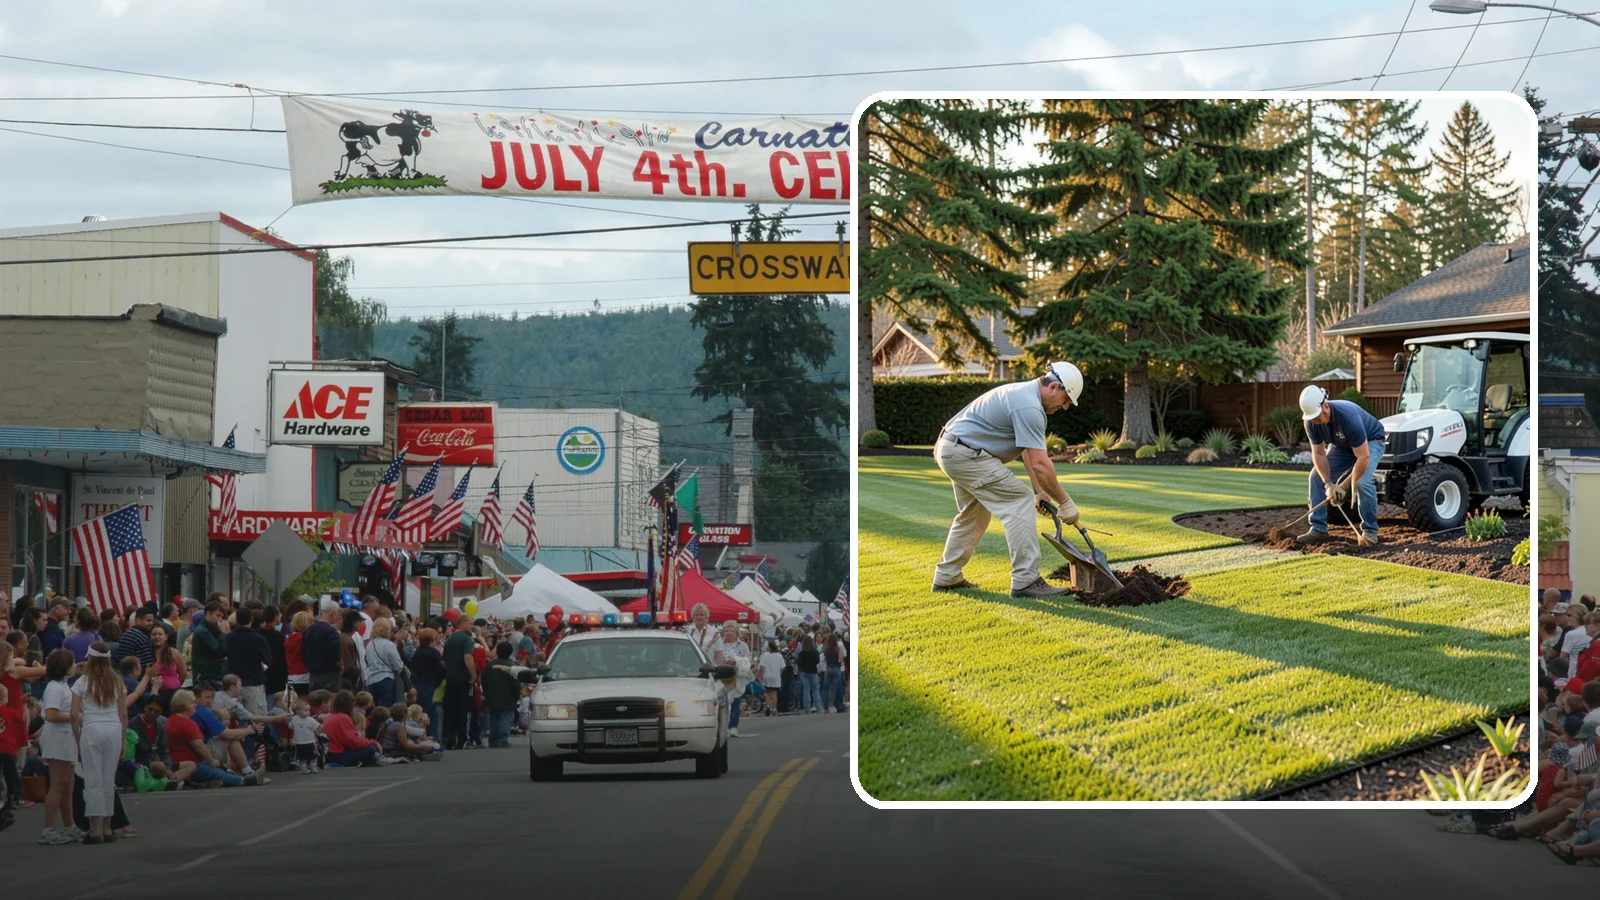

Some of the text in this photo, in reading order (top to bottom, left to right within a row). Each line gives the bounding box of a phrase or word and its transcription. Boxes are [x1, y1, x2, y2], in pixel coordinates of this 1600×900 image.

[481, 140, 605, 193] JULY
[632, 150, 746, 198] 4th.
[697, 253, 850, 280] CROSSWA
[282, 380, 373, 420] ACE
[405, 409, 485, 422] CEDAR LOG
[283, 421, 371, 436] Hardware
[416, 428, 477, 447] Coca-Cola
[353, 467, 386, 480] Simpl
[96, 485, 124, 495] Vincent
[126, 486, 136, 495] de
[138, 486, 155, 495] Paul
[688, 526, 741, 535] CRNATION
[699, 535, 730, 543] GLASS
